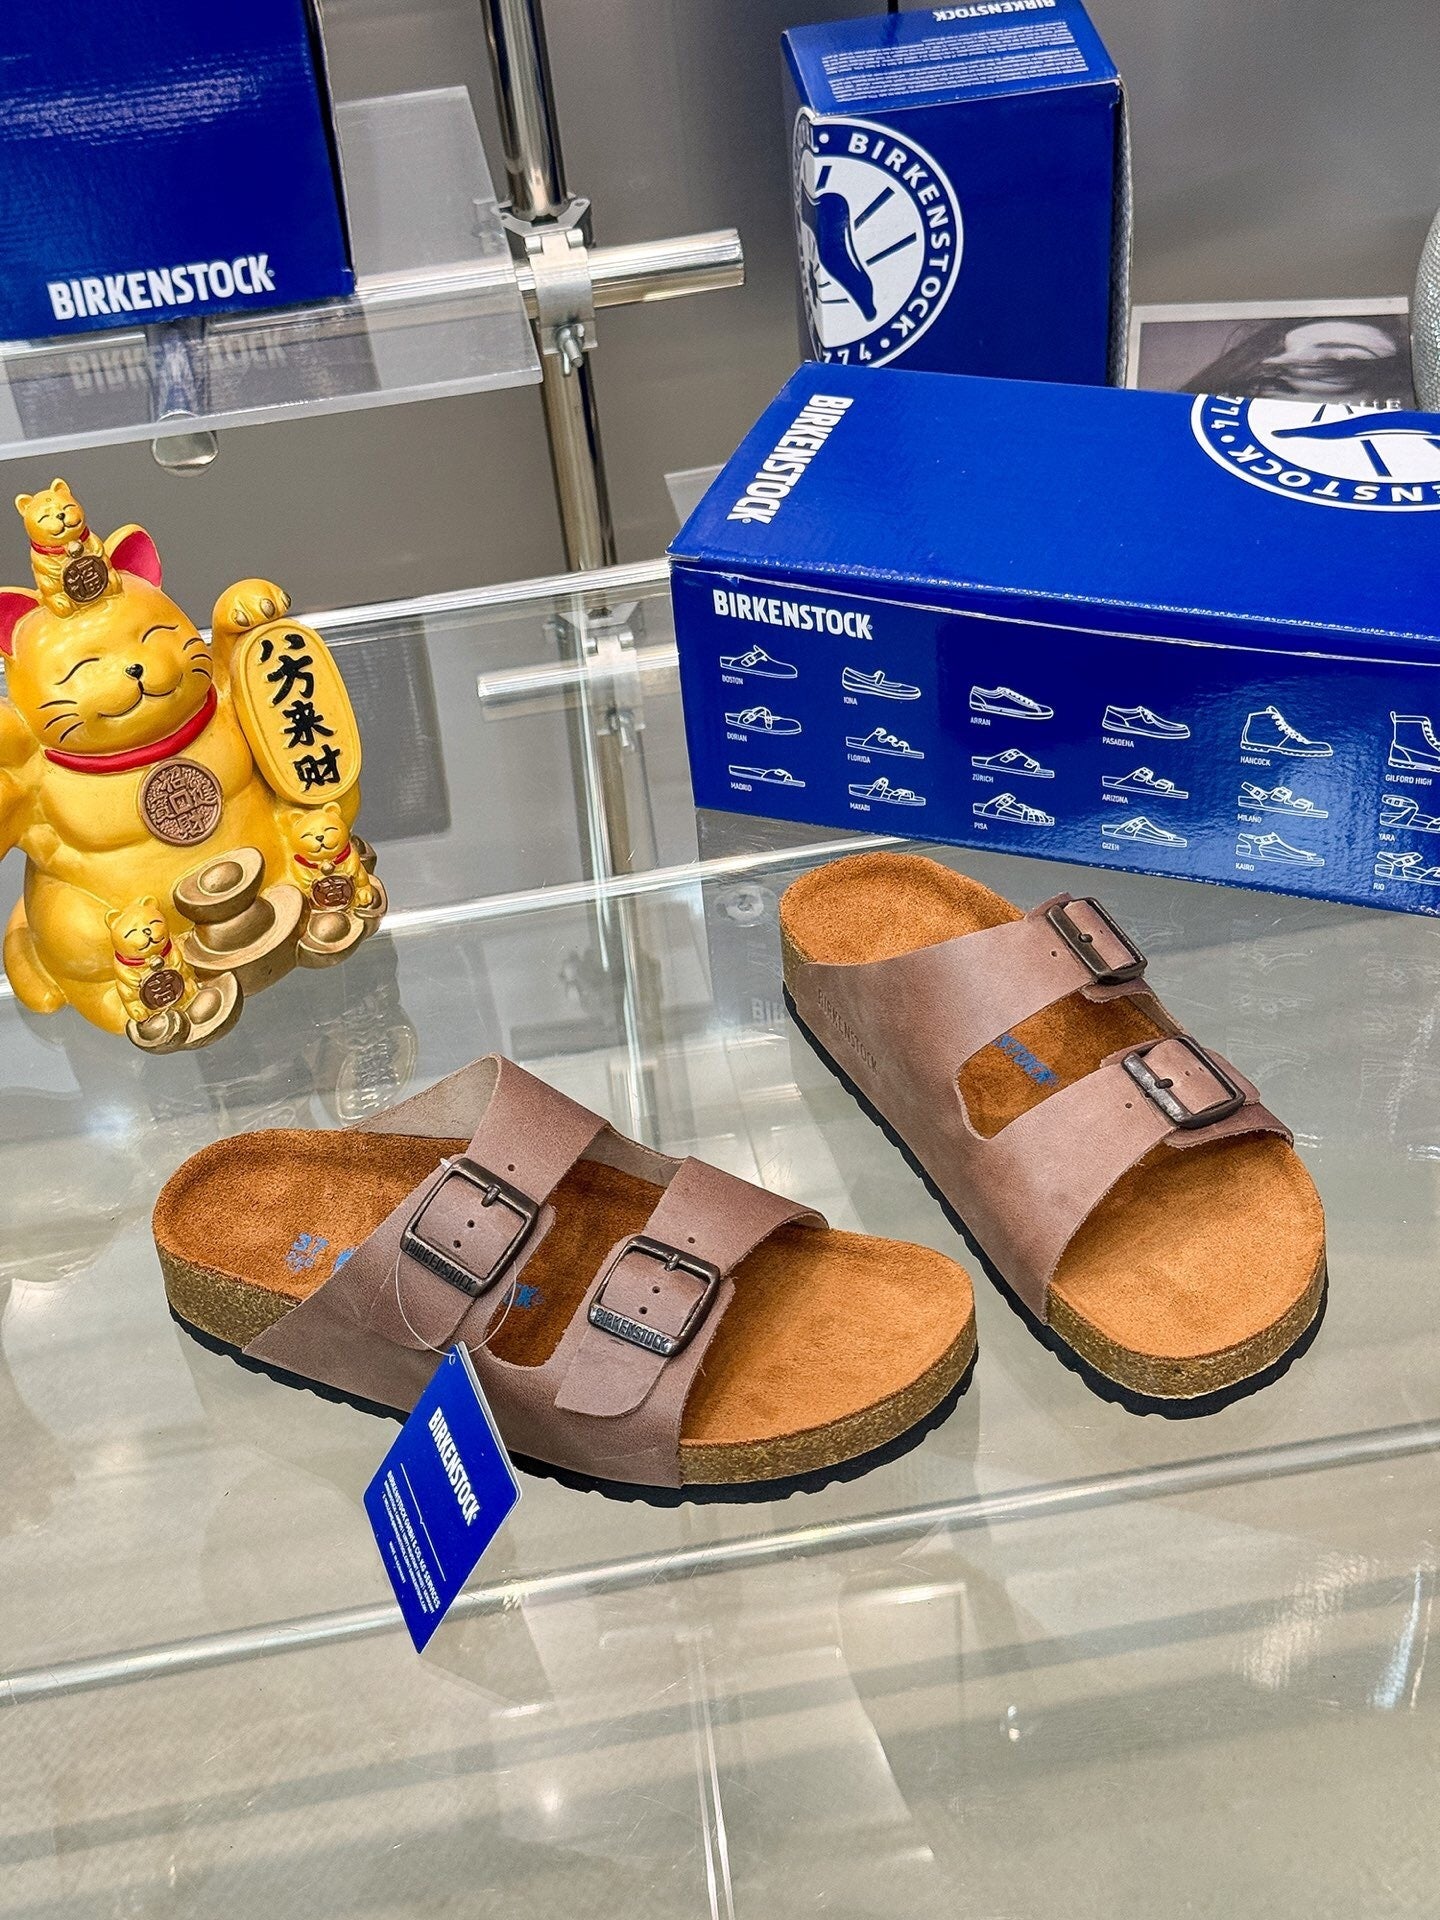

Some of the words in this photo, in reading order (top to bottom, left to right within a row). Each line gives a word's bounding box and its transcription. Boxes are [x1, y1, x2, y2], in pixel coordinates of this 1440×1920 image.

[848, 132, 950, 338] BIRKENSTOCK
[47, 254, 276, 320] BIRKENSTOCK
[726, 394, 855, 525] BIRKENSTOCK
[712, 589, 873, 640] BIRKENSTOCK
[721, 674, 744, 685] BOSTON
[260, 634, 342, 792] 八方来财
[726, 731, 748, 743] DORIAN
[1102, 736, 1135, 748] PASADENA
[847, 753, 871, 764] FLORIDA
[1240, 756, 1271, 767] HANCOCK
[1385, 773, 1414, 784] GILFORD
[1415, 777, 1433, 786] HIGH
[730, 781, 753, 792] MADRID
[1101, 793, 1129, 805] ARIZONA
[1237, 813, 1262, 824] MILANO
[973, 822, 989, 831] PISA
[1378, 832, 1395, 842] YARA
[1101, 841, 1120, 851] GIZEH
[1235, 862, 1255, 872] KAIRO
[1373, 882, 1385, 891] RIO
[405, 1238, 477, 1292] BIRKENSTOCK
[593, 1307, 671, 1353] BIRKENSTOCK
[427, 1406, 480, 1527] BIRKENSTOCK
